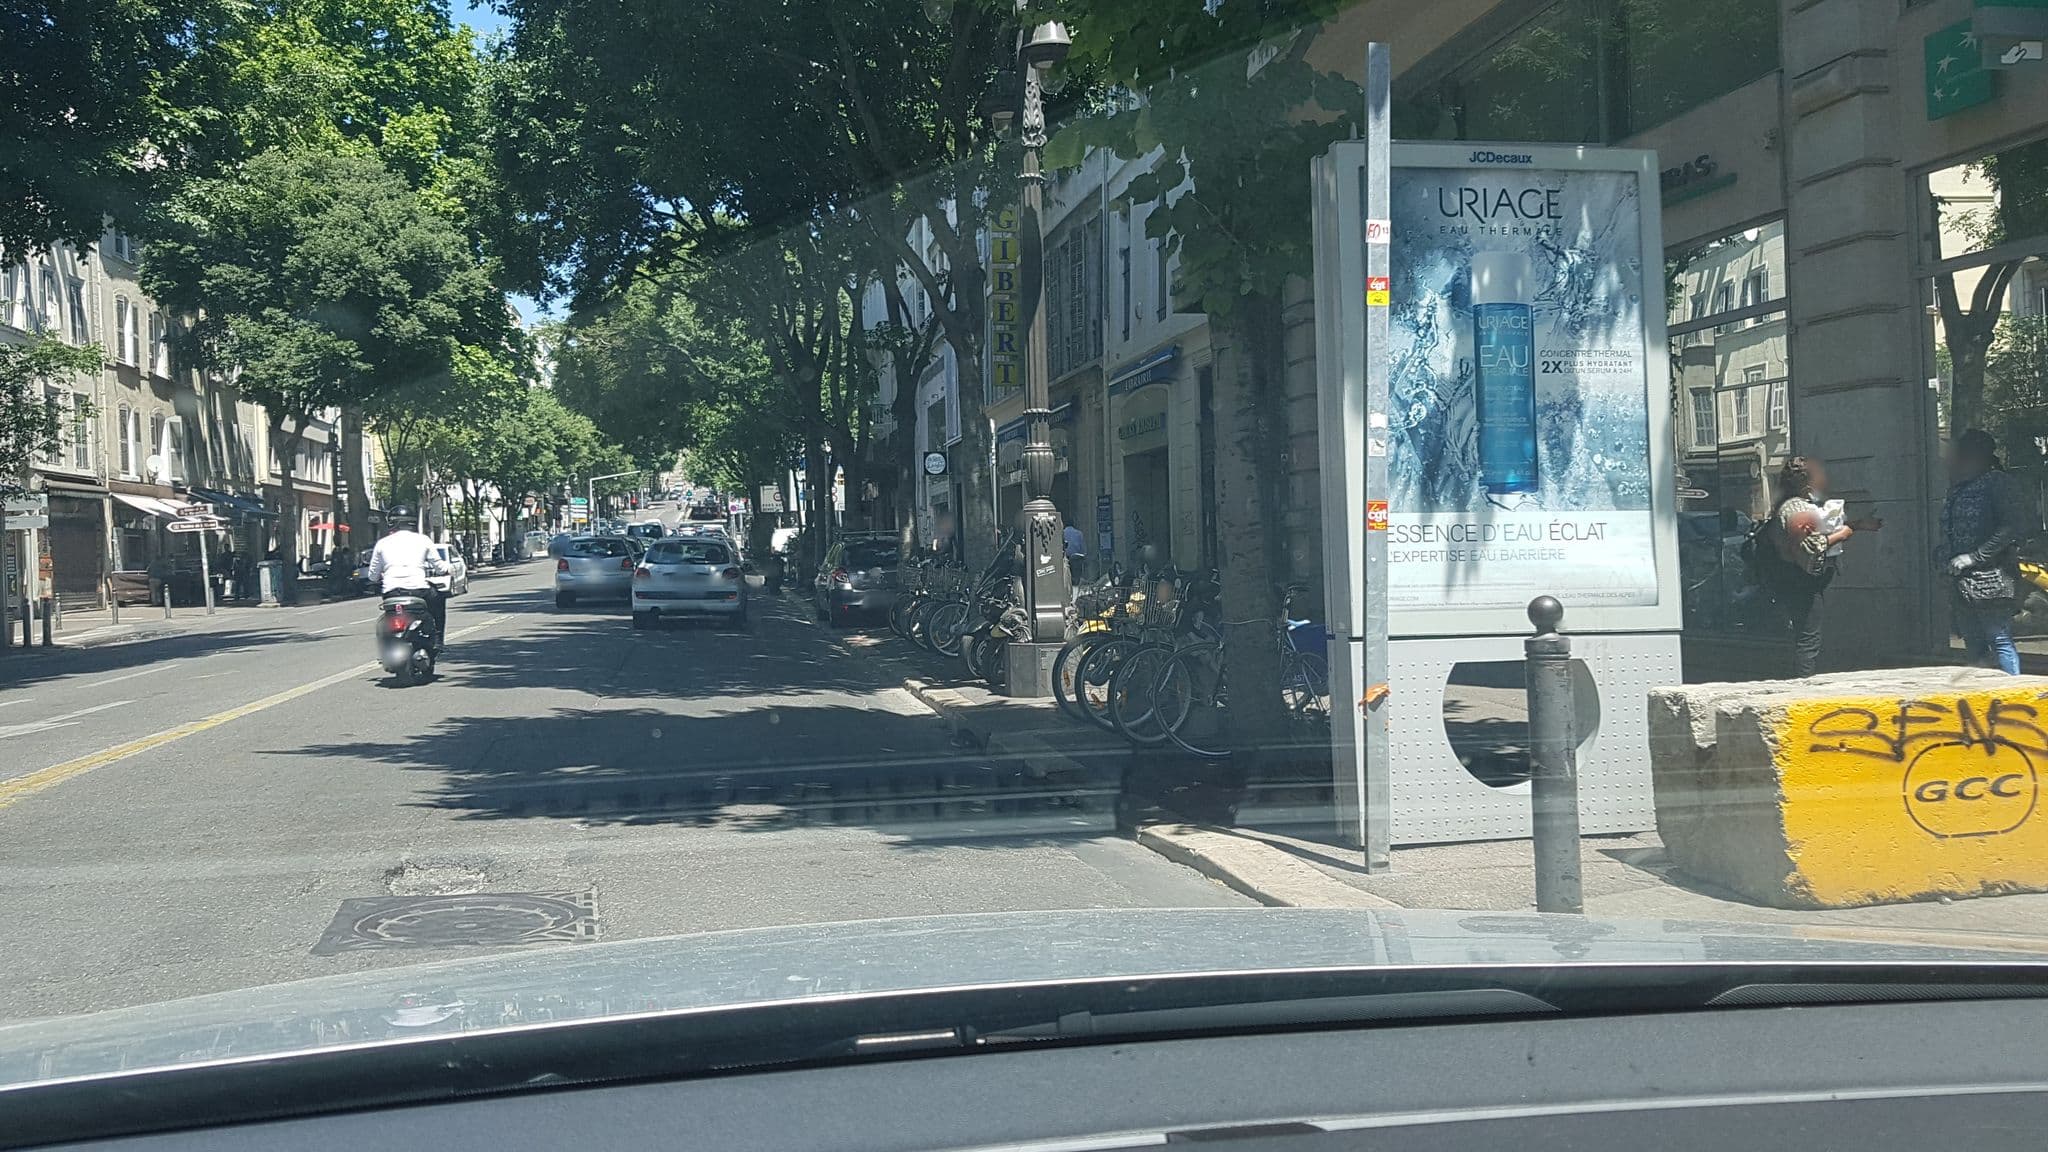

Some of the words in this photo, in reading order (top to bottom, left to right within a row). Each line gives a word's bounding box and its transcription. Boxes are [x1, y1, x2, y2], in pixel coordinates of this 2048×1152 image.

[1469, 151, 1533, 163] JCDecaux
[1438, 187, 1563, 224] URIAGE
[1440, 225, 1468, 234] EAU
[1479, 226, 1562, 236] THERMALE
[995, 209, 1017, 384] GIBERT
[1478, 316, 1529, 330] URIAGE
[1480, 345, 1528, 368] EAU
[1593, 350, 1632, 358] THERMAL
[1541, 361, 1563, 374] 2X
[1368, 510, 1387, 522] cgt
[1387, 523, 1478, 543] ESSENCE
[1549, 518, 1608, 541] ÉCLAT
[1470, 549, 1496, 561] EAU
[1914, 773, 2024, 802] GCC
